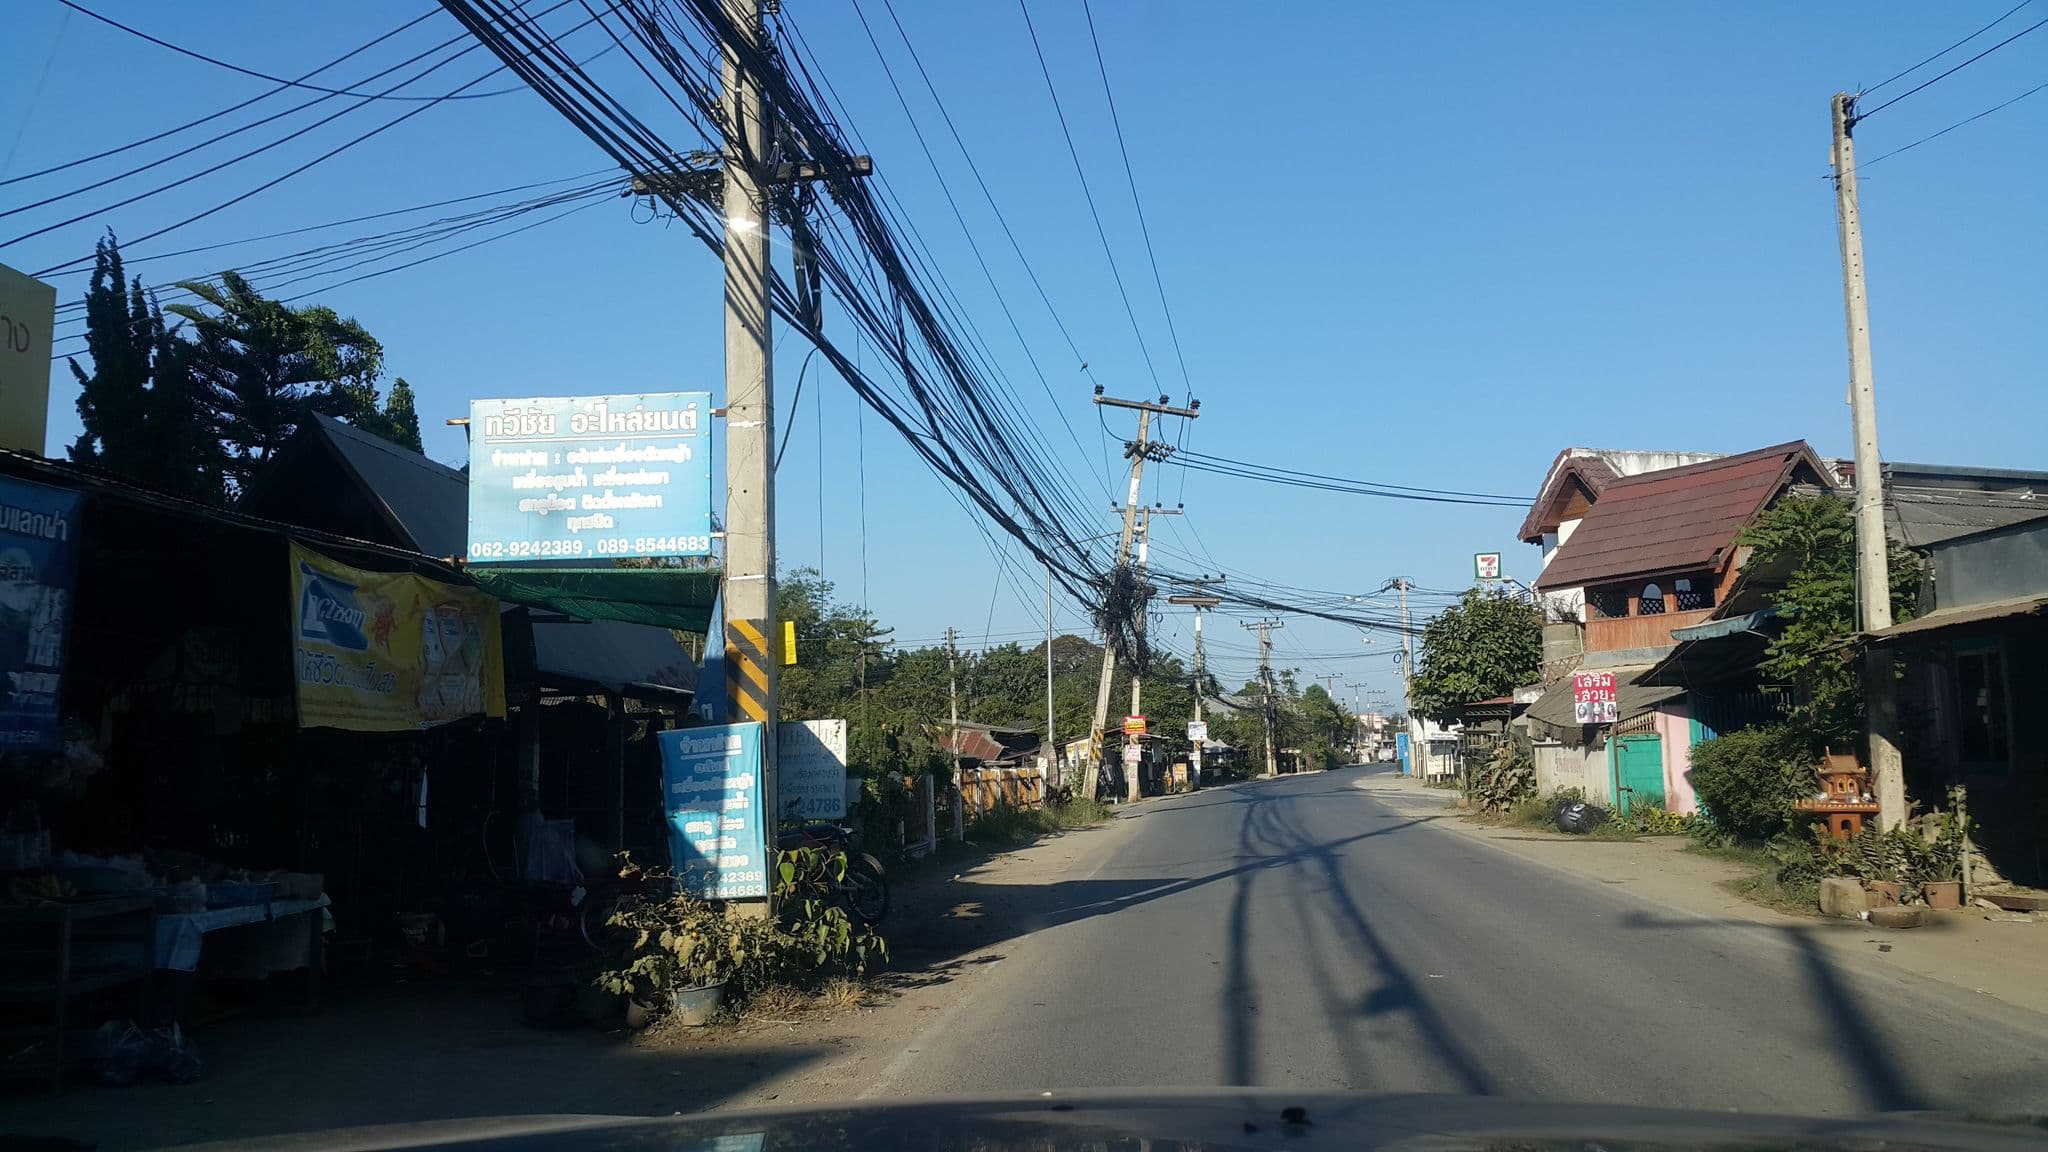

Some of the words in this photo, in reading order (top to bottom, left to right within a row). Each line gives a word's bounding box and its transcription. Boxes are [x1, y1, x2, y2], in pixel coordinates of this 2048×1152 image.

[484, 407, 556, 437] ทวีชัย
[570, 401, 698, 433] อะไหล่ยนต์
[471, 539, 584, 558] 062-9242389
[597, 535, 709, 556] 089-8544683
[1577, 672, 1611, 688] เสริม
[1581, 689, 1609, 701] สวย
